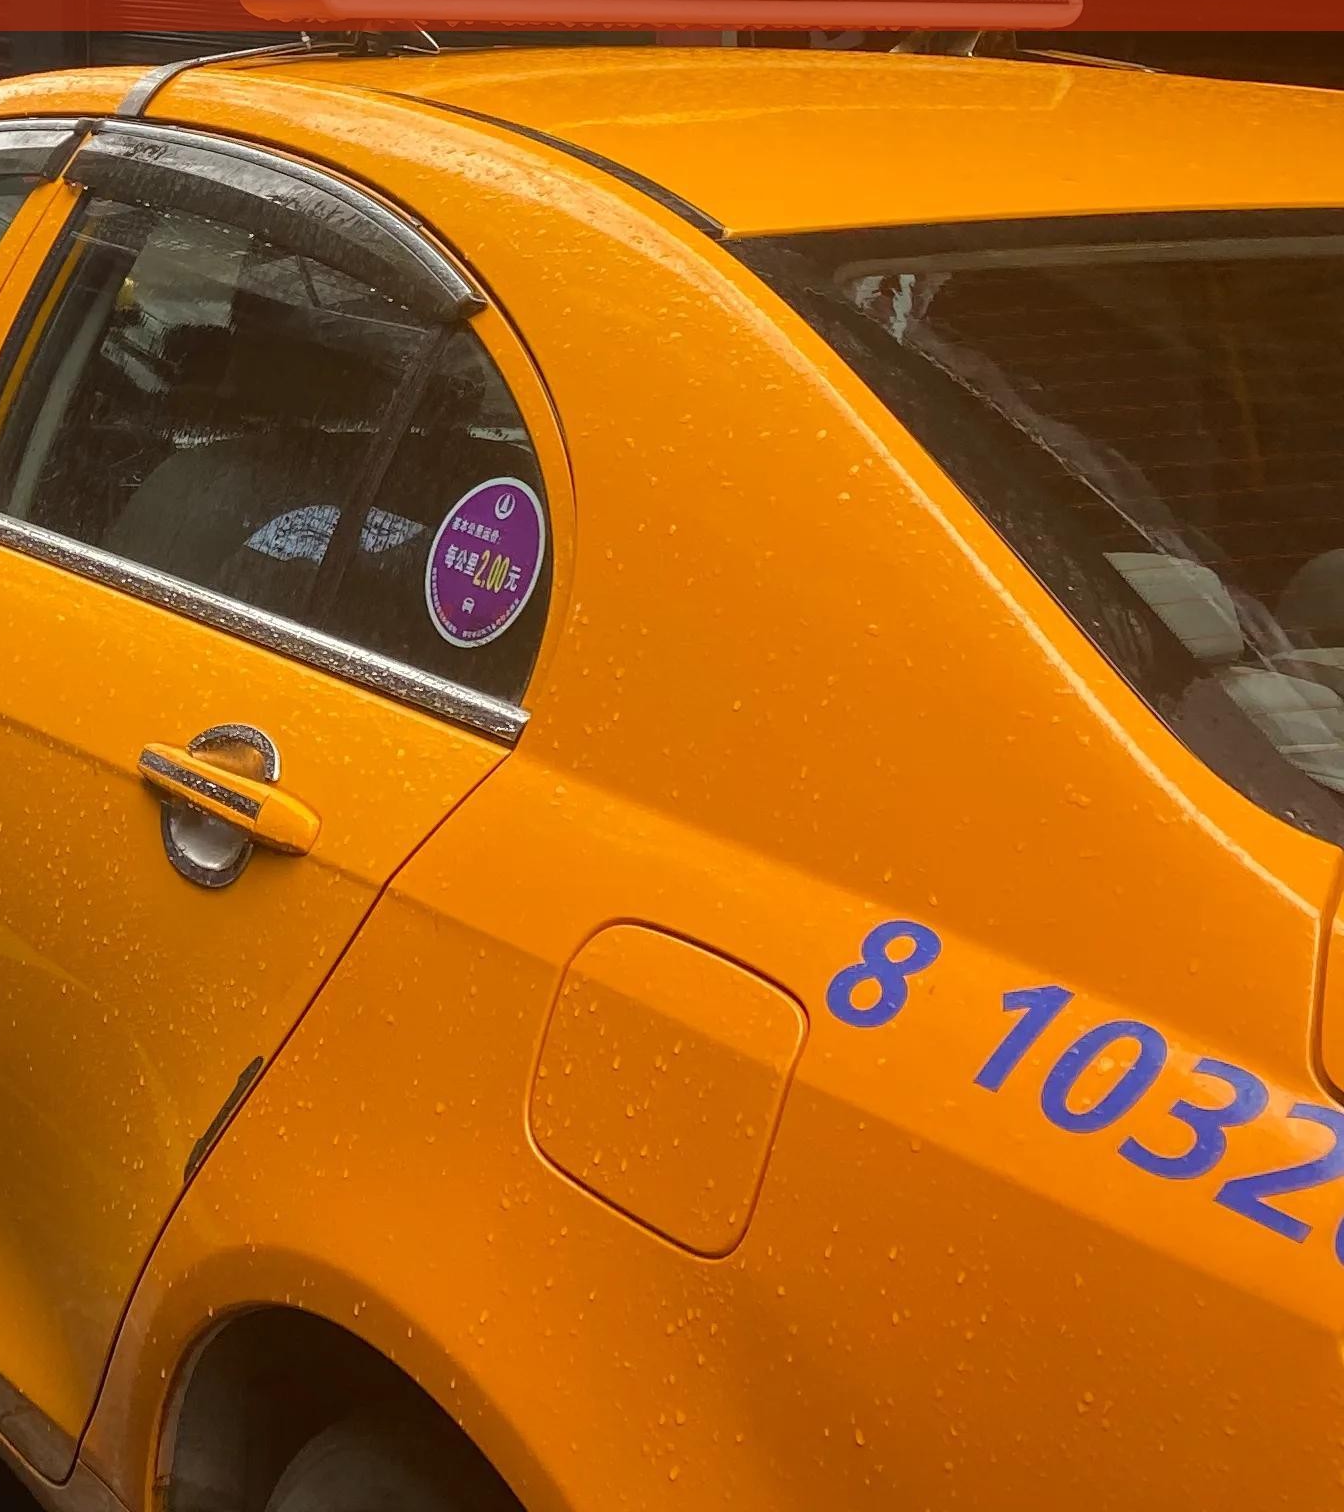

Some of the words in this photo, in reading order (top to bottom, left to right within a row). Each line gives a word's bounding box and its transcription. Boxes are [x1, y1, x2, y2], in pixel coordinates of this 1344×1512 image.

[444, 544, 522, 594] 每公里2.00元
[826, 919, 942, 1028] 8
[973, 984, 1344, 1269] 1032
